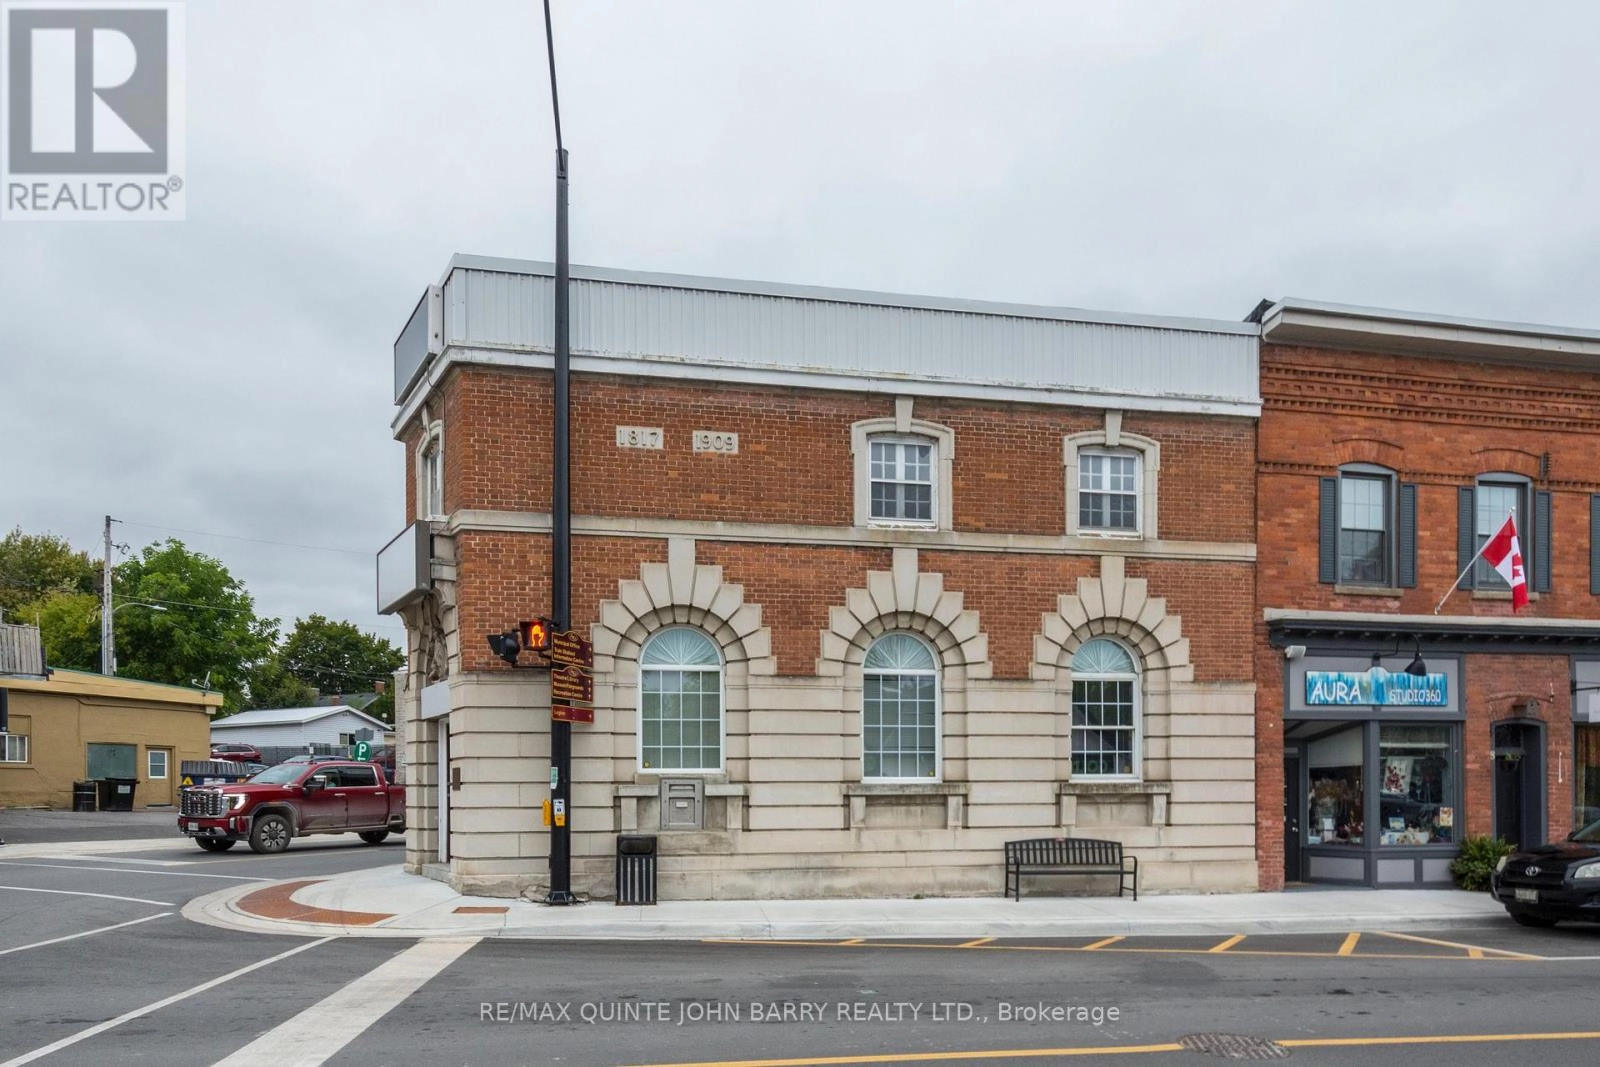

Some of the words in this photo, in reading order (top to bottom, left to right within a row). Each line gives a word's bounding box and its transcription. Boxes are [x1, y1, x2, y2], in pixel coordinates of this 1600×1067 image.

[618, 429, 660, 448] 1817
[694, 433, 735, 451] 1909
[1310, 679, 1362, 704] AURA
[358, 743, 367, 756] P
